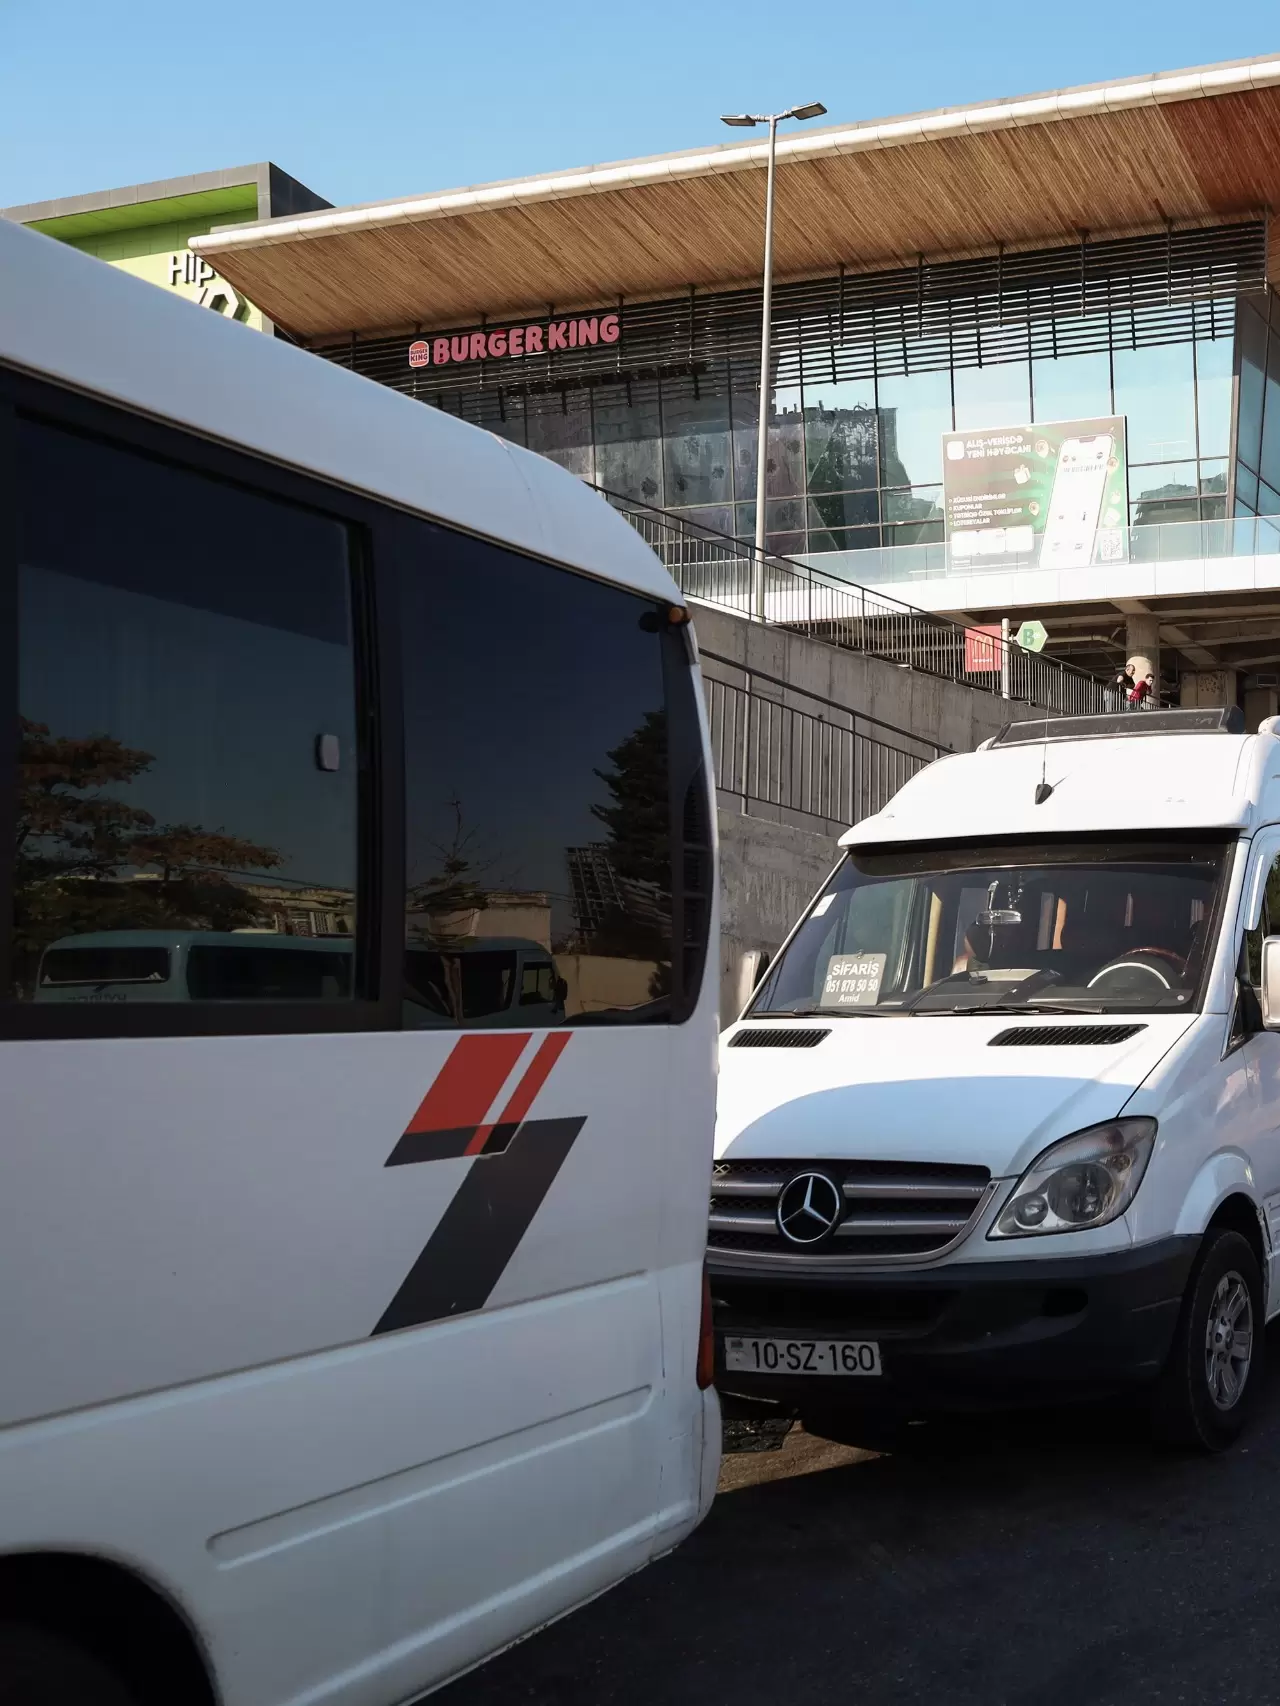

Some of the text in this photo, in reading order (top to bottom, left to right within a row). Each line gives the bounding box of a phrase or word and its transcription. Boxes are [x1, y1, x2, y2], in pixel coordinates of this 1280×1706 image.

[433, 315, 620, 365] BURGER KING
[410, 353, 428, 362] KING
[831, 960, 880, 978] SİFARİŞ
[826, 978, 879, 993] 051 878 50 50
[838, 993, 860, 1003] Amid
[751, 1341, 875, 1372] 10-SZ-160
